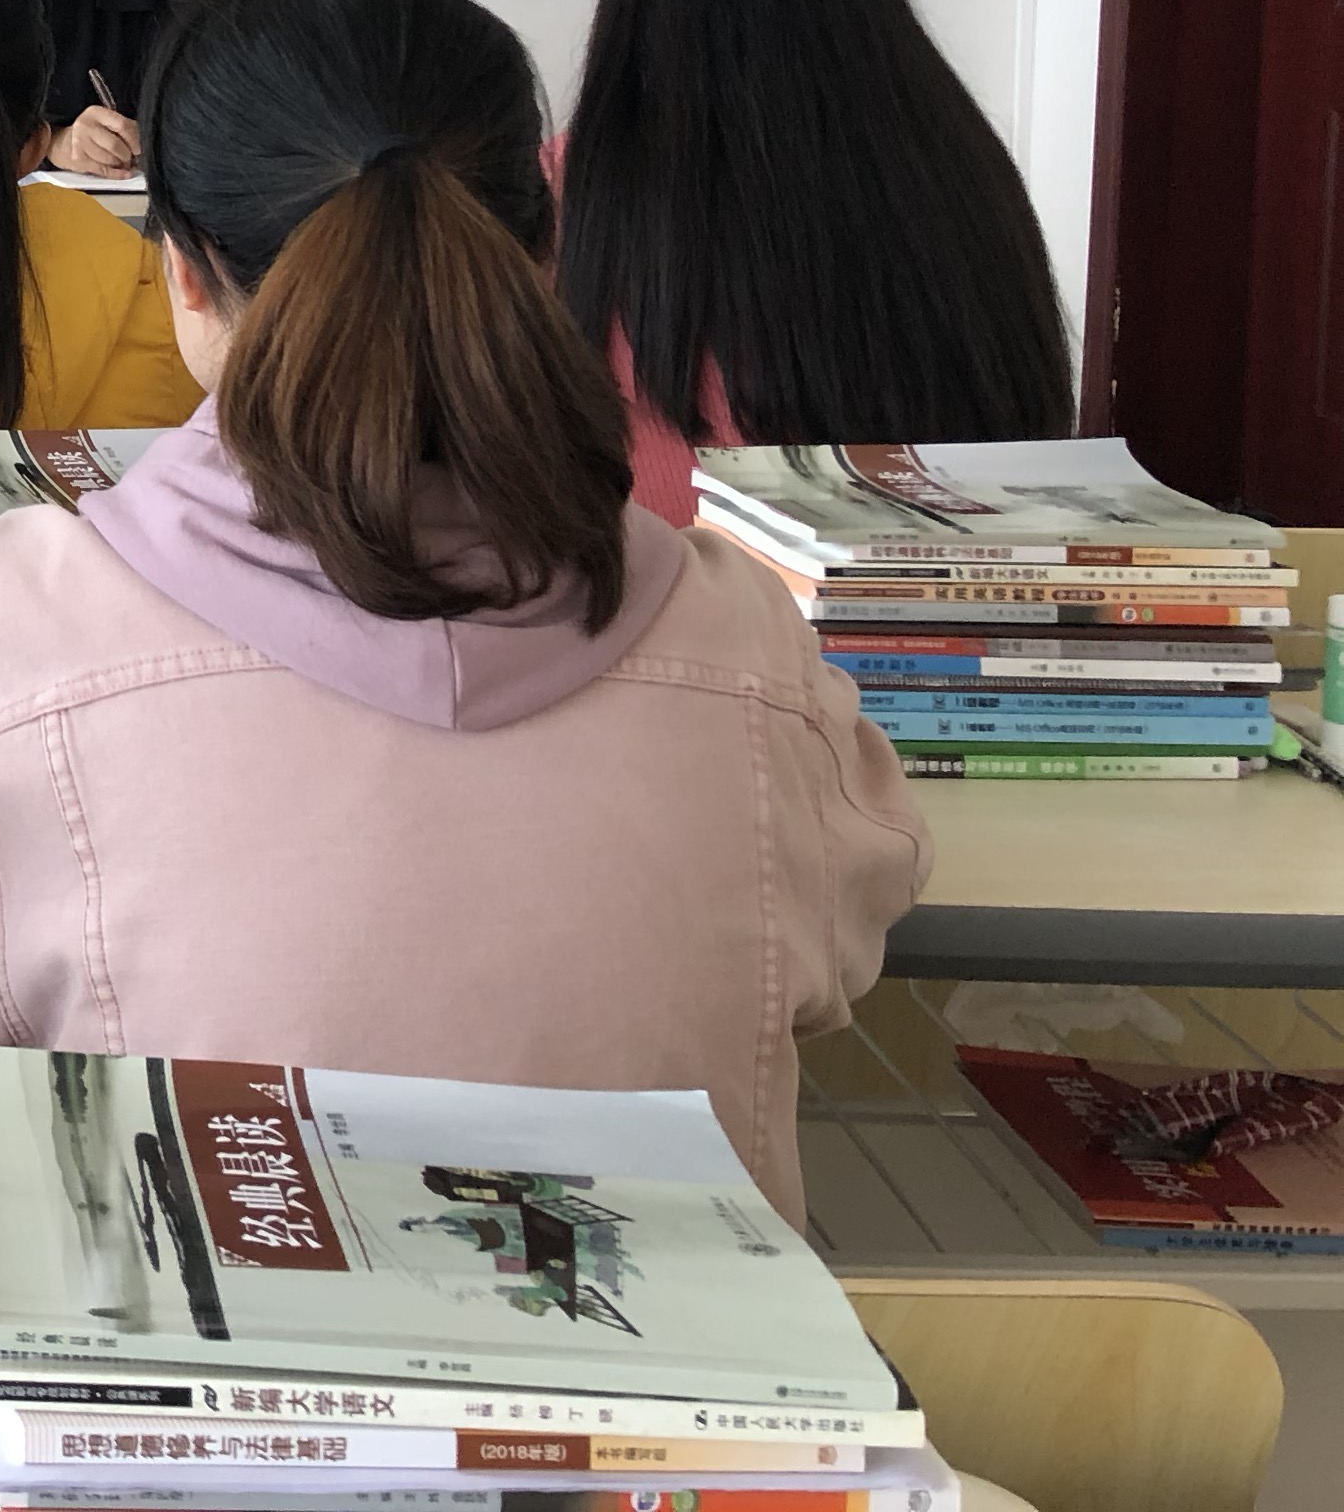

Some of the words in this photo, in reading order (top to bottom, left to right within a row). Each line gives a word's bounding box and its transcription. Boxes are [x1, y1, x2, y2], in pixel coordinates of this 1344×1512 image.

[230, 1387, 395, 1418] 新编大学语文
